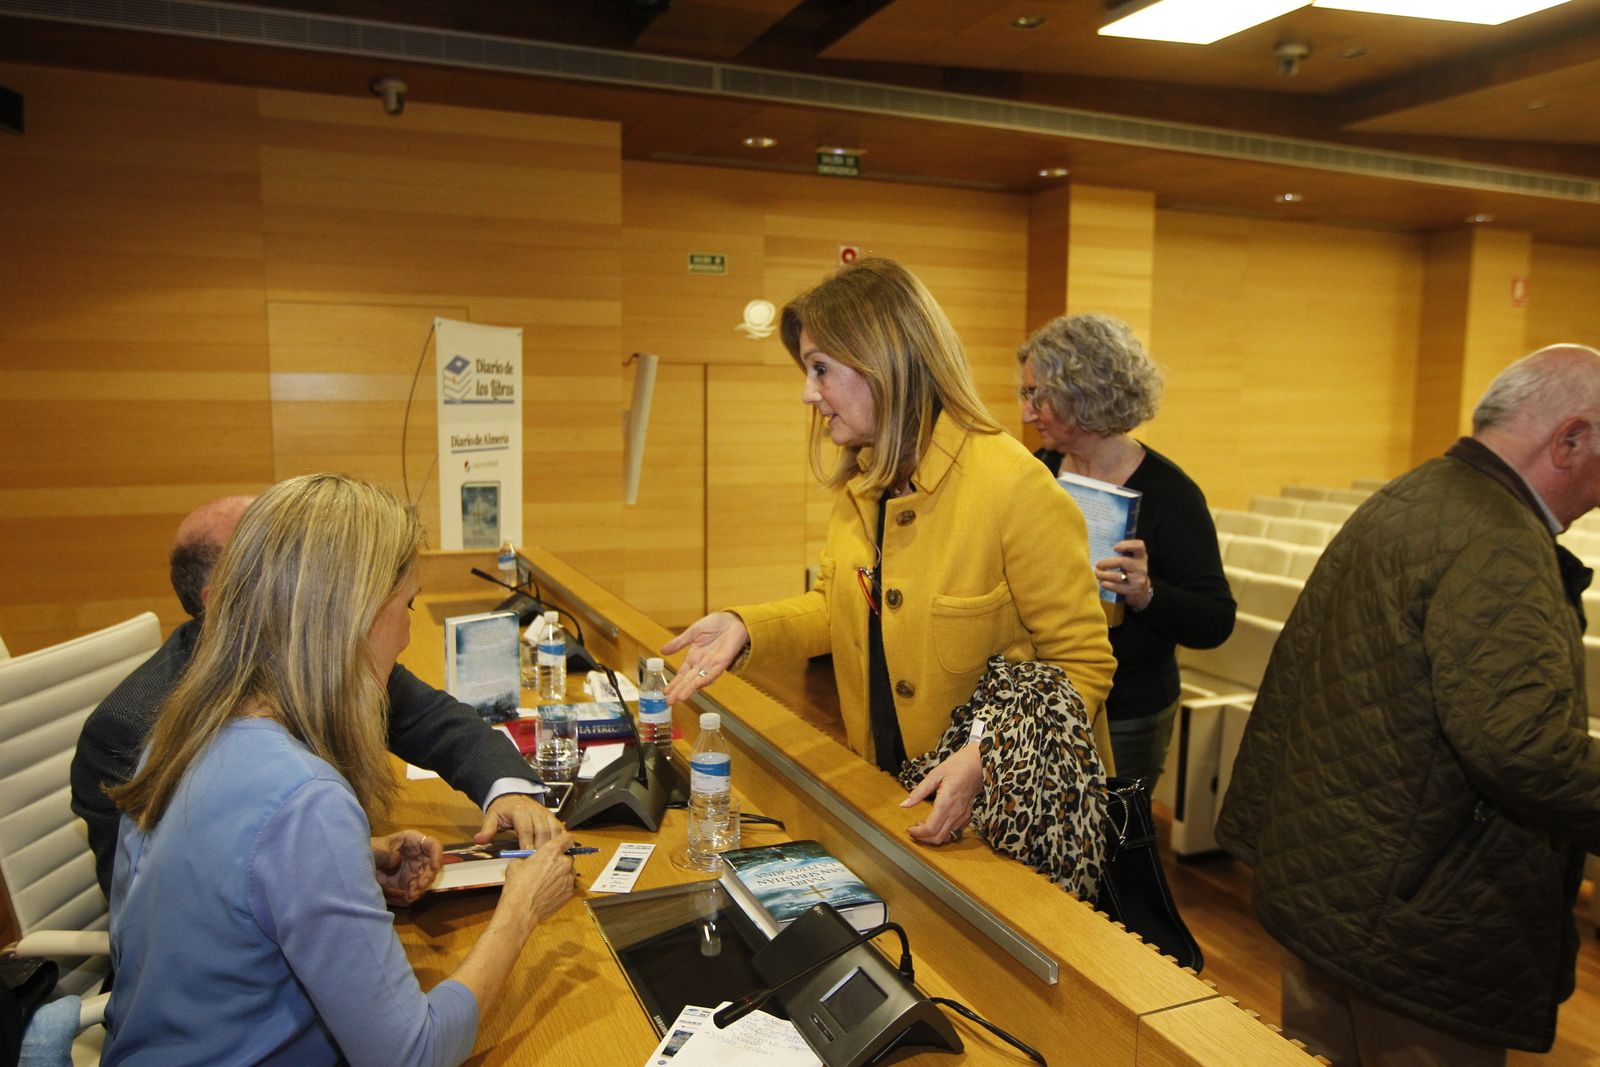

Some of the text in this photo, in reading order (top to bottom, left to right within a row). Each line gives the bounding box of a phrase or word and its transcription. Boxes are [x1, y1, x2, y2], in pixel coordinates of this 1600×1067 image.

[475, 359, 514, 375] Diario de
[475, 380, 514, 400] los Libros
[451, 434, 472, 448] Diario
[473, 434, 482, 446] de
[579, 725, 591, 734] LA
[754, 864, 819, 879] PEREGRINA
[821, 867, 846, 875] SAN
[789, 876, 826, 887] ISABEL
